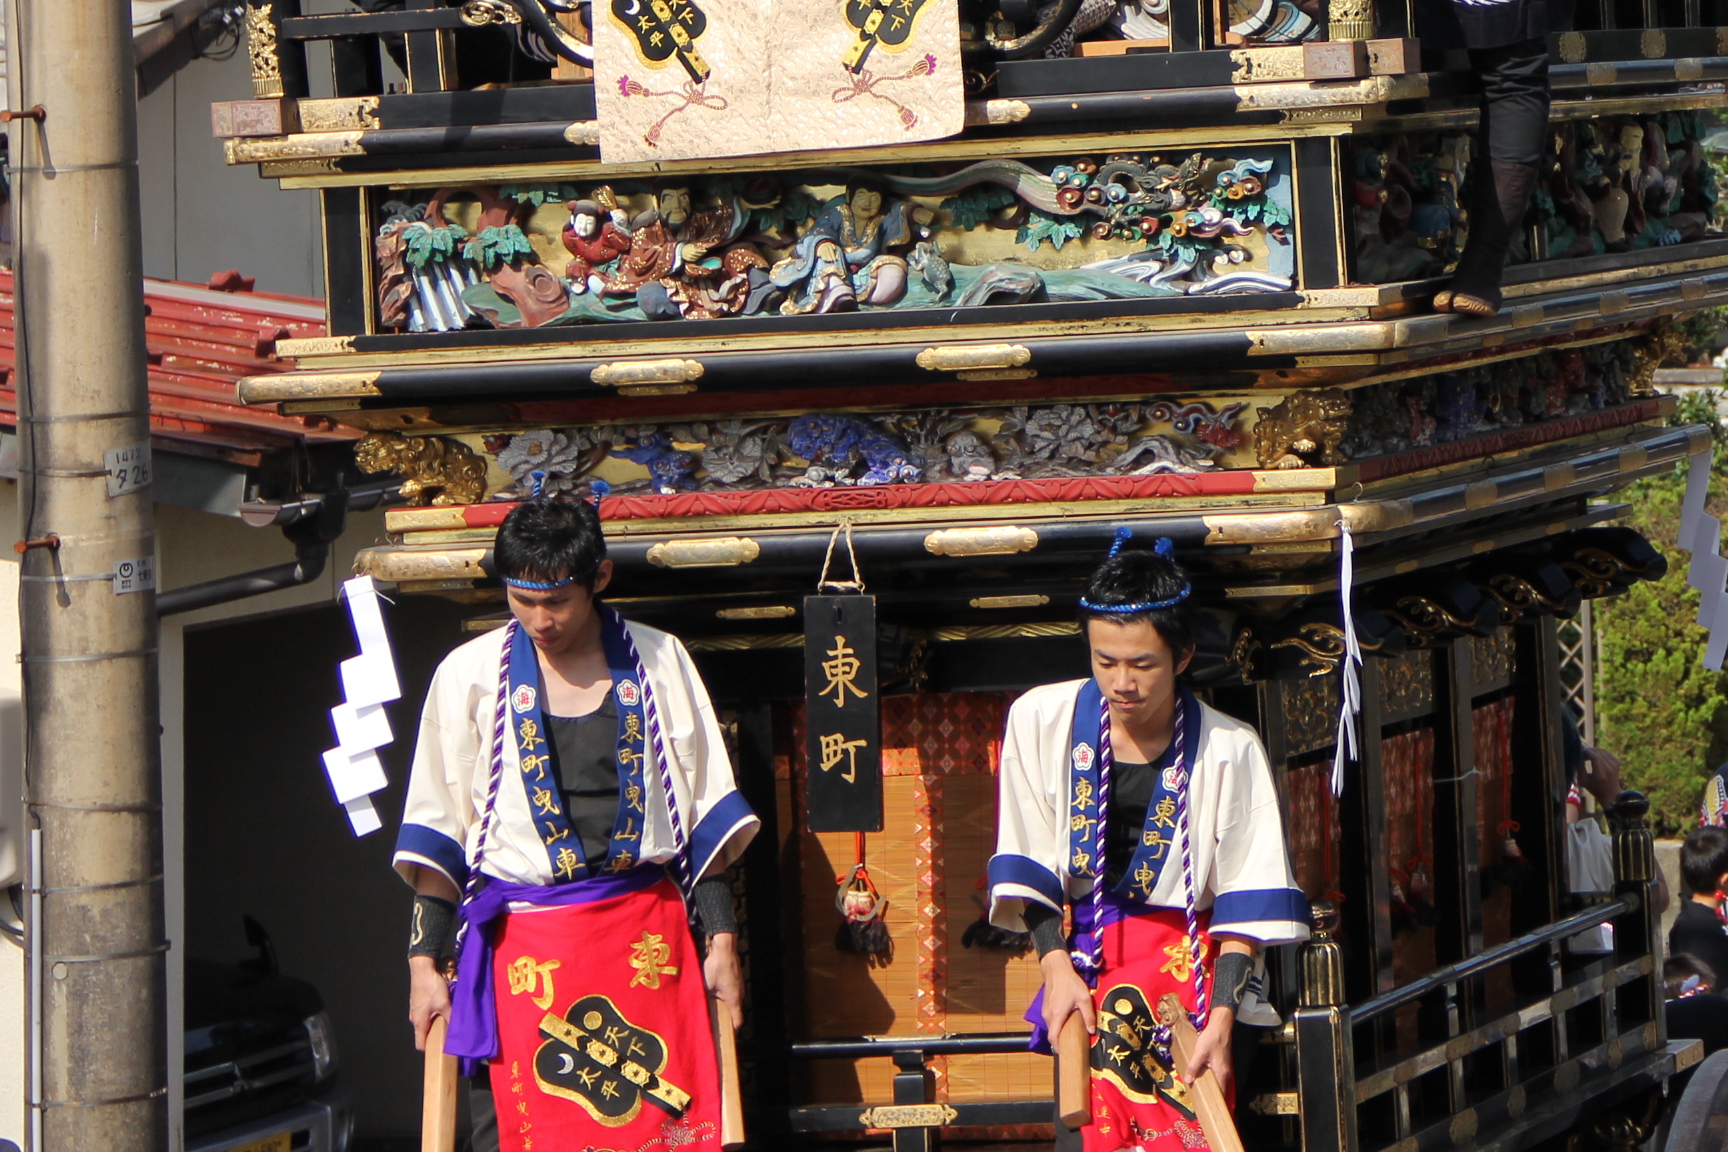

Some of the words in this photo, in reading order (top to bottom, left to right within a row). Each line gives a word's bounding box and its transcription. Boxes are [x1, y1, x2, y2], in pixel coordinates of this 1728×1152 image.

[637, 13, 665, 48] 太平
[516, 692, 530, 707] 海
[622, 686, 635, 700] 海
[818, 634, 869, 784] 東町
[519, 717, 586, 880] 東町曳山車
[603, 710, 644, 875] 東町曳山車
[604, 1025, 646, 1057] 天下
[576, 1065, 621, 1102] 太平
